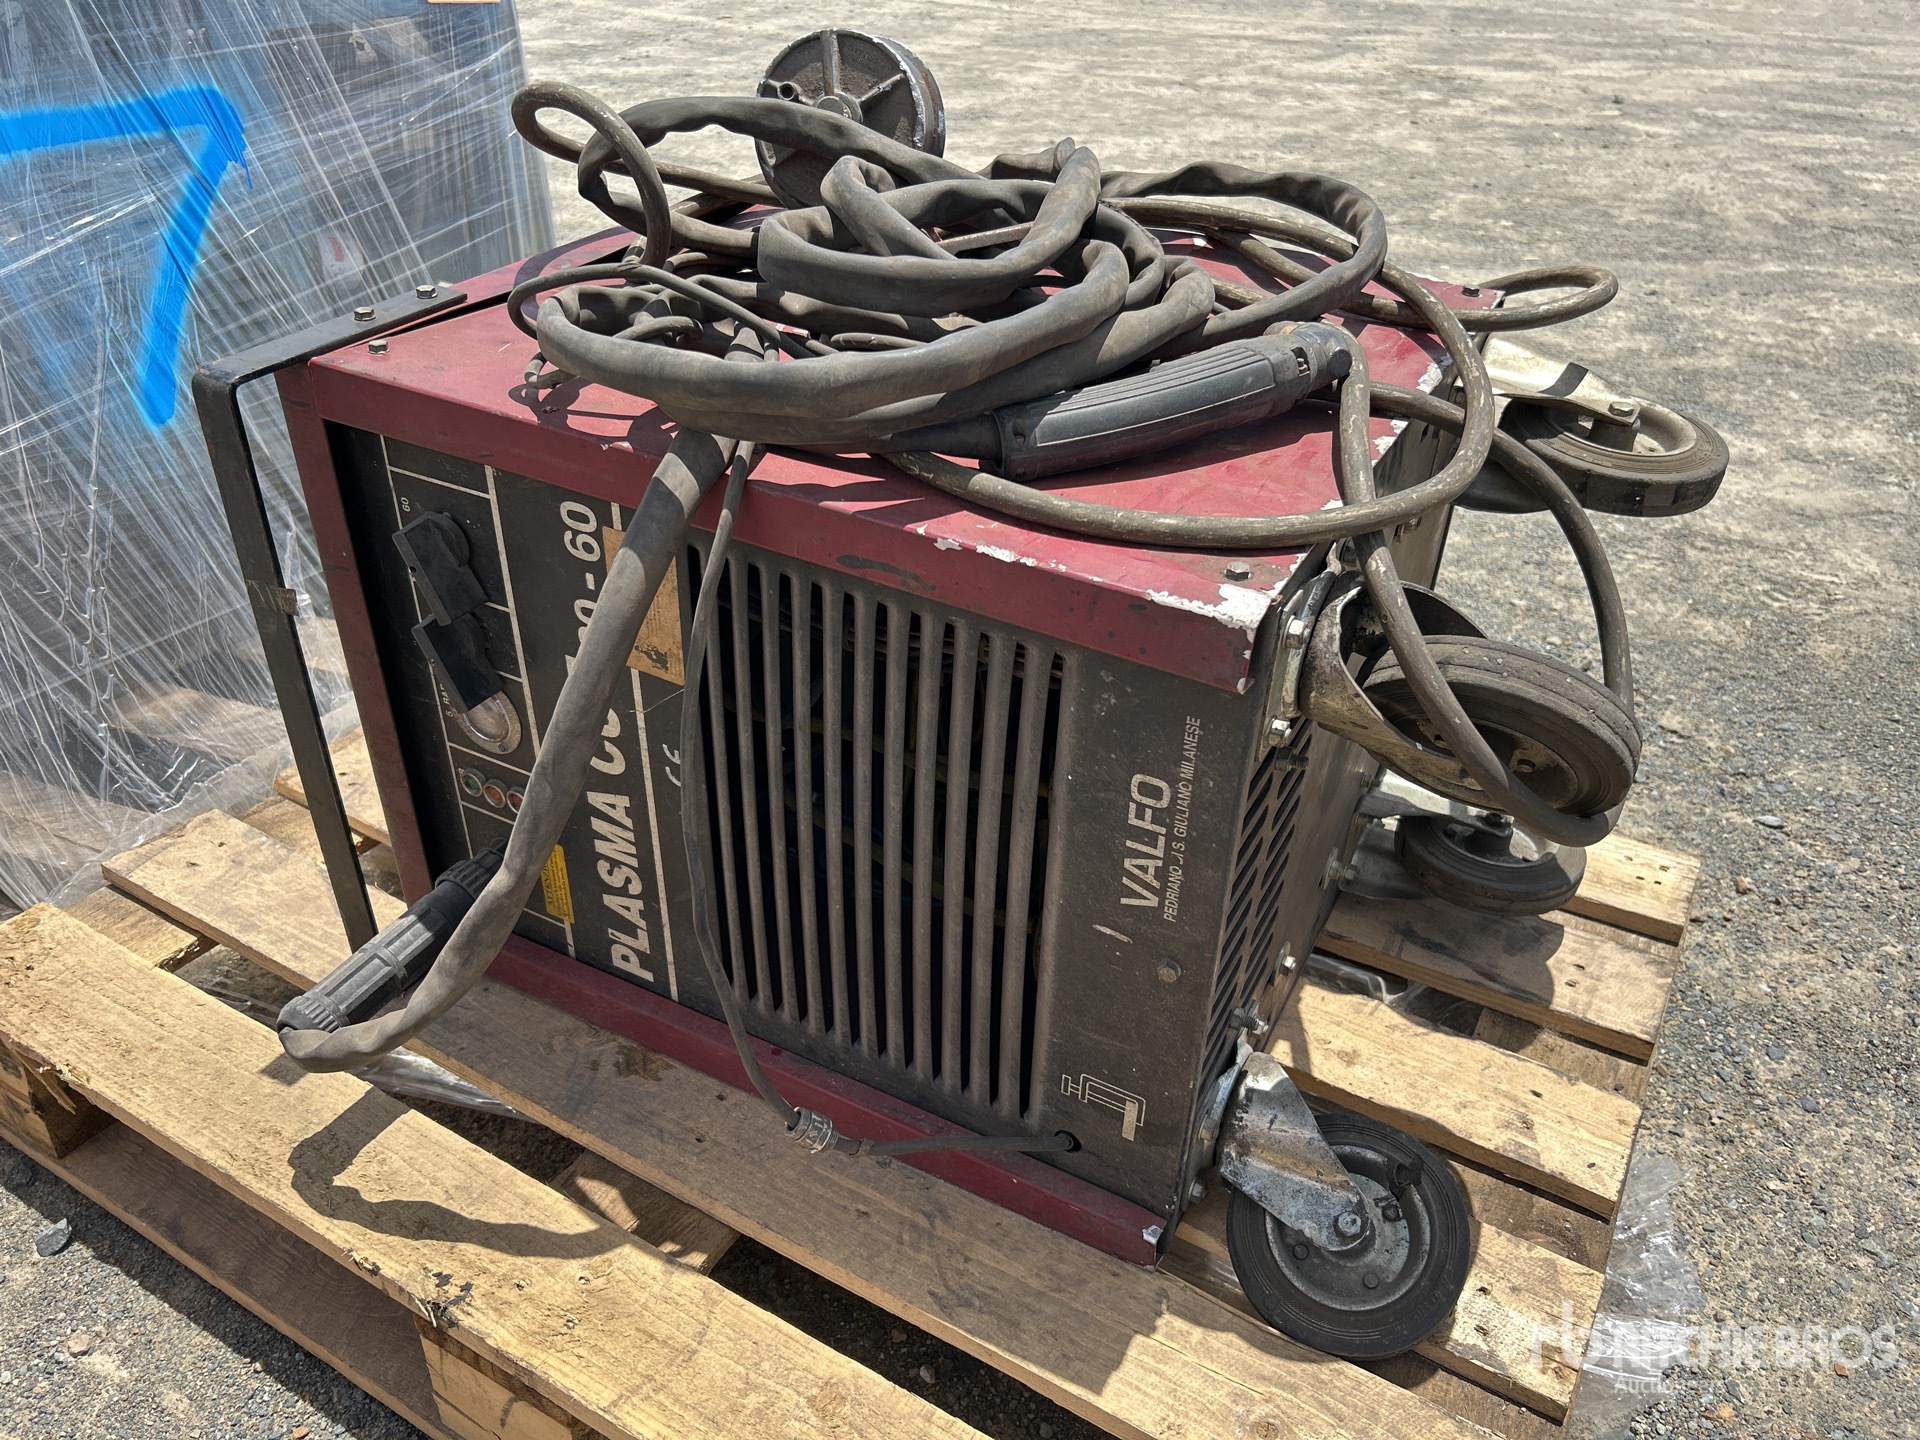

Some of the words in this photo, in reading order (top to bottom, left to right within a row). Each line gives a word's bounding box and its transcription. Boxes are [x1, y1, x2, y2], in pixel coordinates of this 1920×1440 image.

[400, 497, 411, 512] 60
[559, 500, 601, 562] 60
[1180, 715, 1200, 780] MILANESE
[1120, 773, 1171, 908] VALFO
[1174, 781, 1193, 838] GIULIANO
[586, 790, 654, 983] PLASMA
[1163, 865, 1183, 923] PEDRIANO
